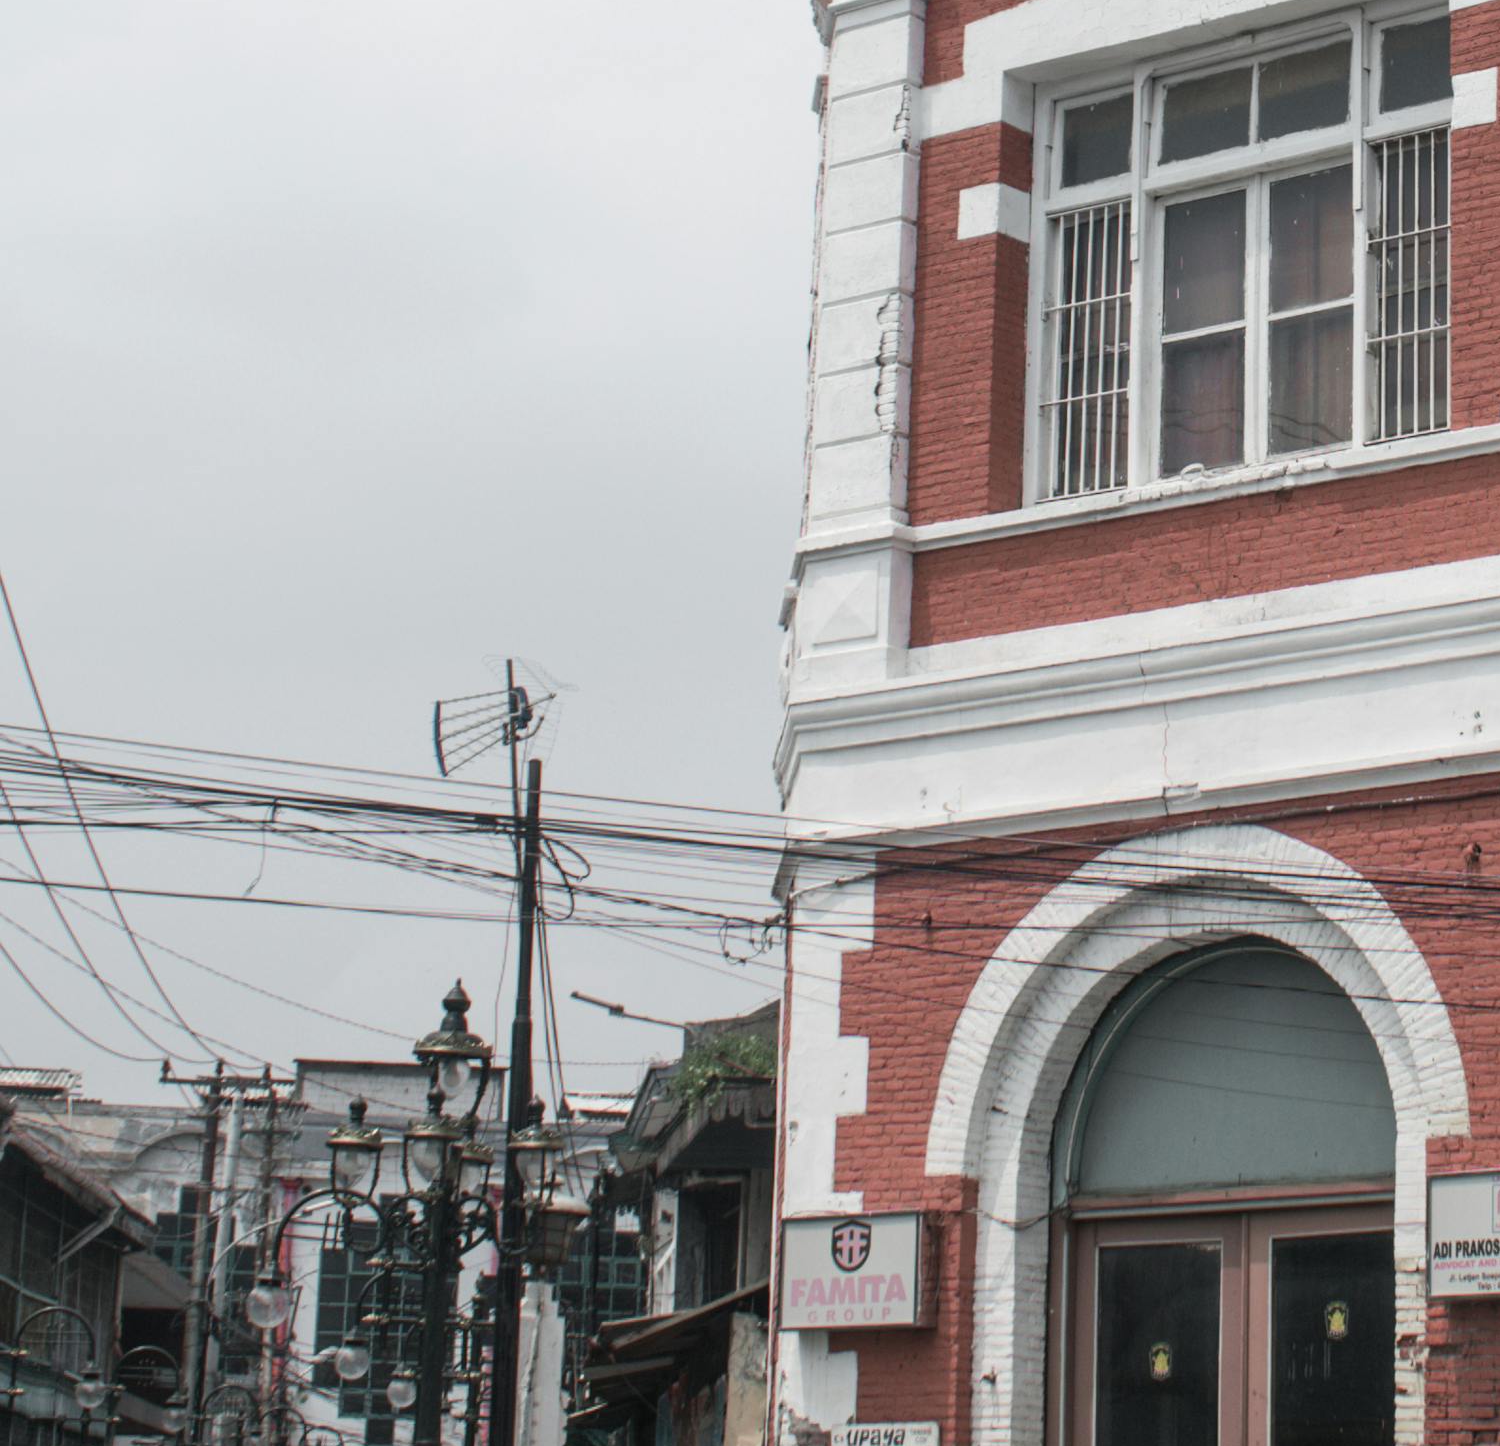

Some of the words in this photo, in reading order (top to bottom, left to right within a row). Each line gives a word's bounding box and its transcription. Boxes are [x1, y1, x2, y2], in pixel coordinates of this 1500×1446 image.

[1433, 1241, 1452, 1259] ADI
[1434, 1260, 1475, 1270] ADVOCAT
[1478, 1258, 1497, 1267] AND
[790, 1273, 907, 1307] FAMITA
[807, 1306, 891, 1323] GROUP
